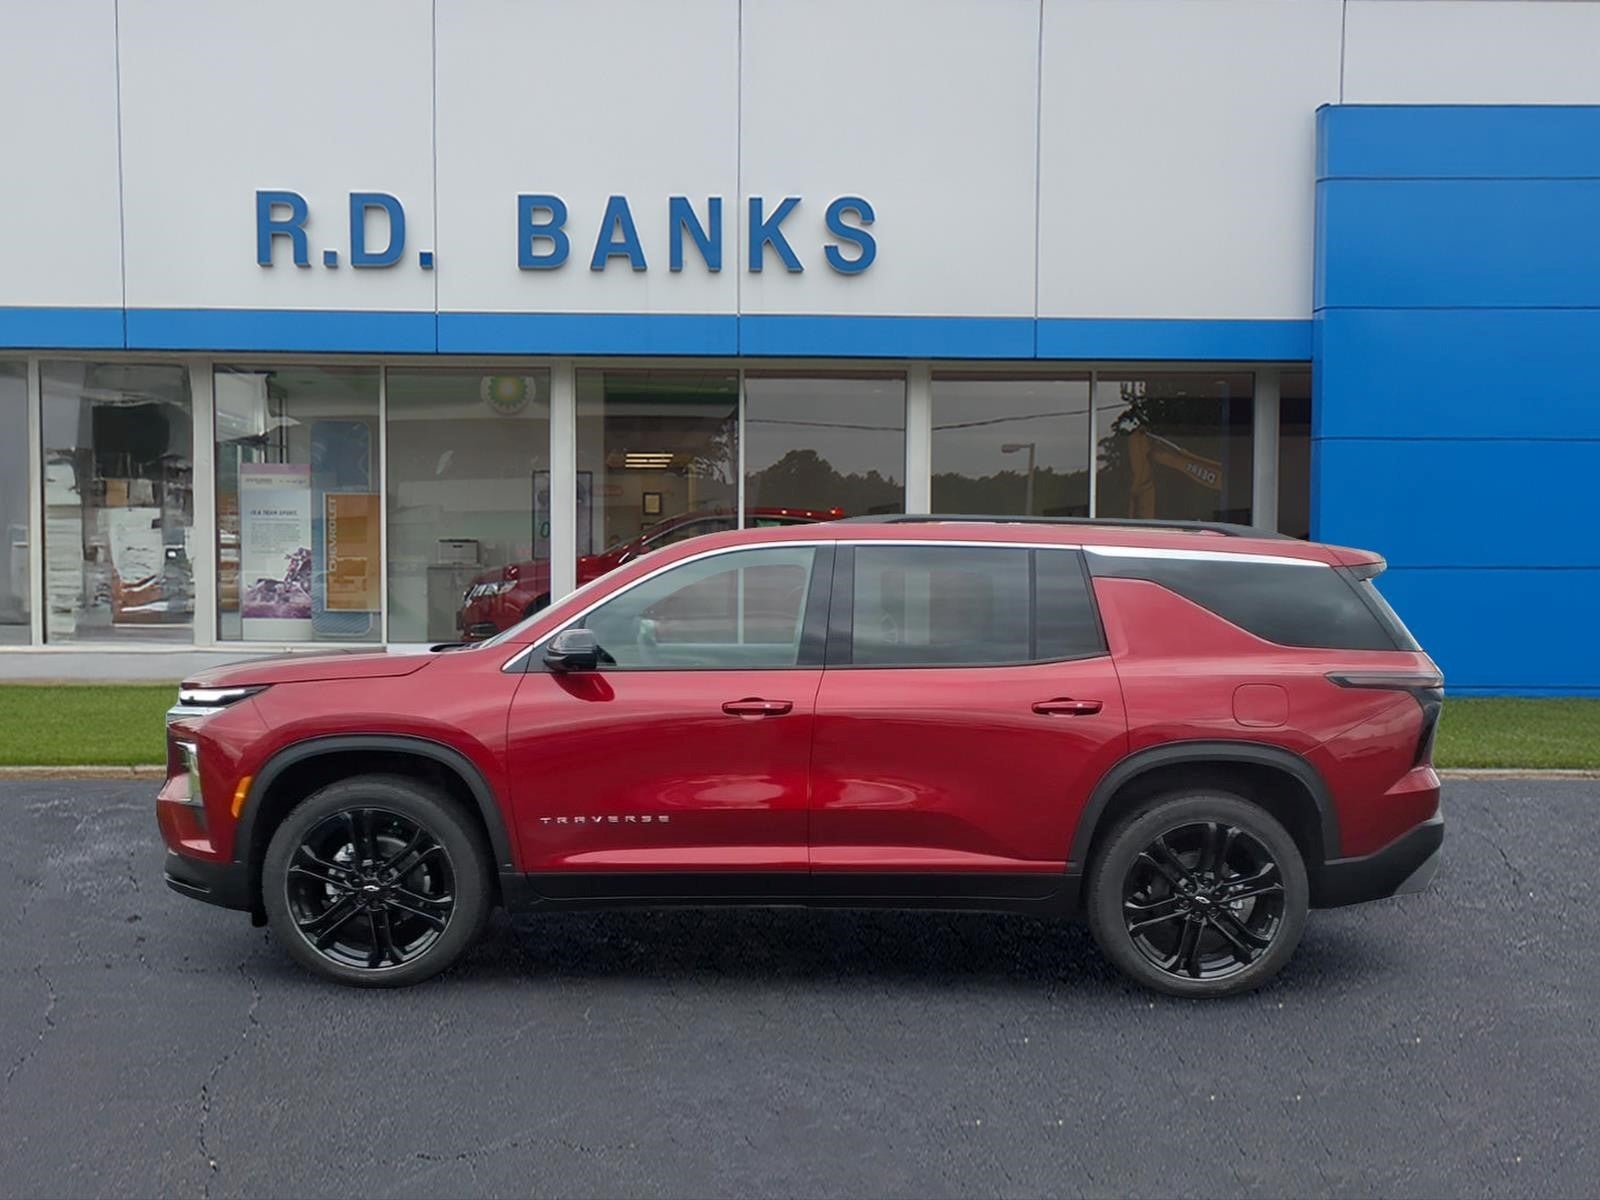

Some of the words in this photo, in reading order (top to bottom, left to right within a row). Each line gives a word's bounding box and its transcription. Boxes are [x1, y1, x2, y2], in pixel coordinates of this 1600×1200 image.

[256, 190, 434, 270] R.D.
[517, 194, 877, 275] BANKS
[327, 497, 337, 573] CHEVROLET
[539, 815, 670, 824] TRAVERSE
